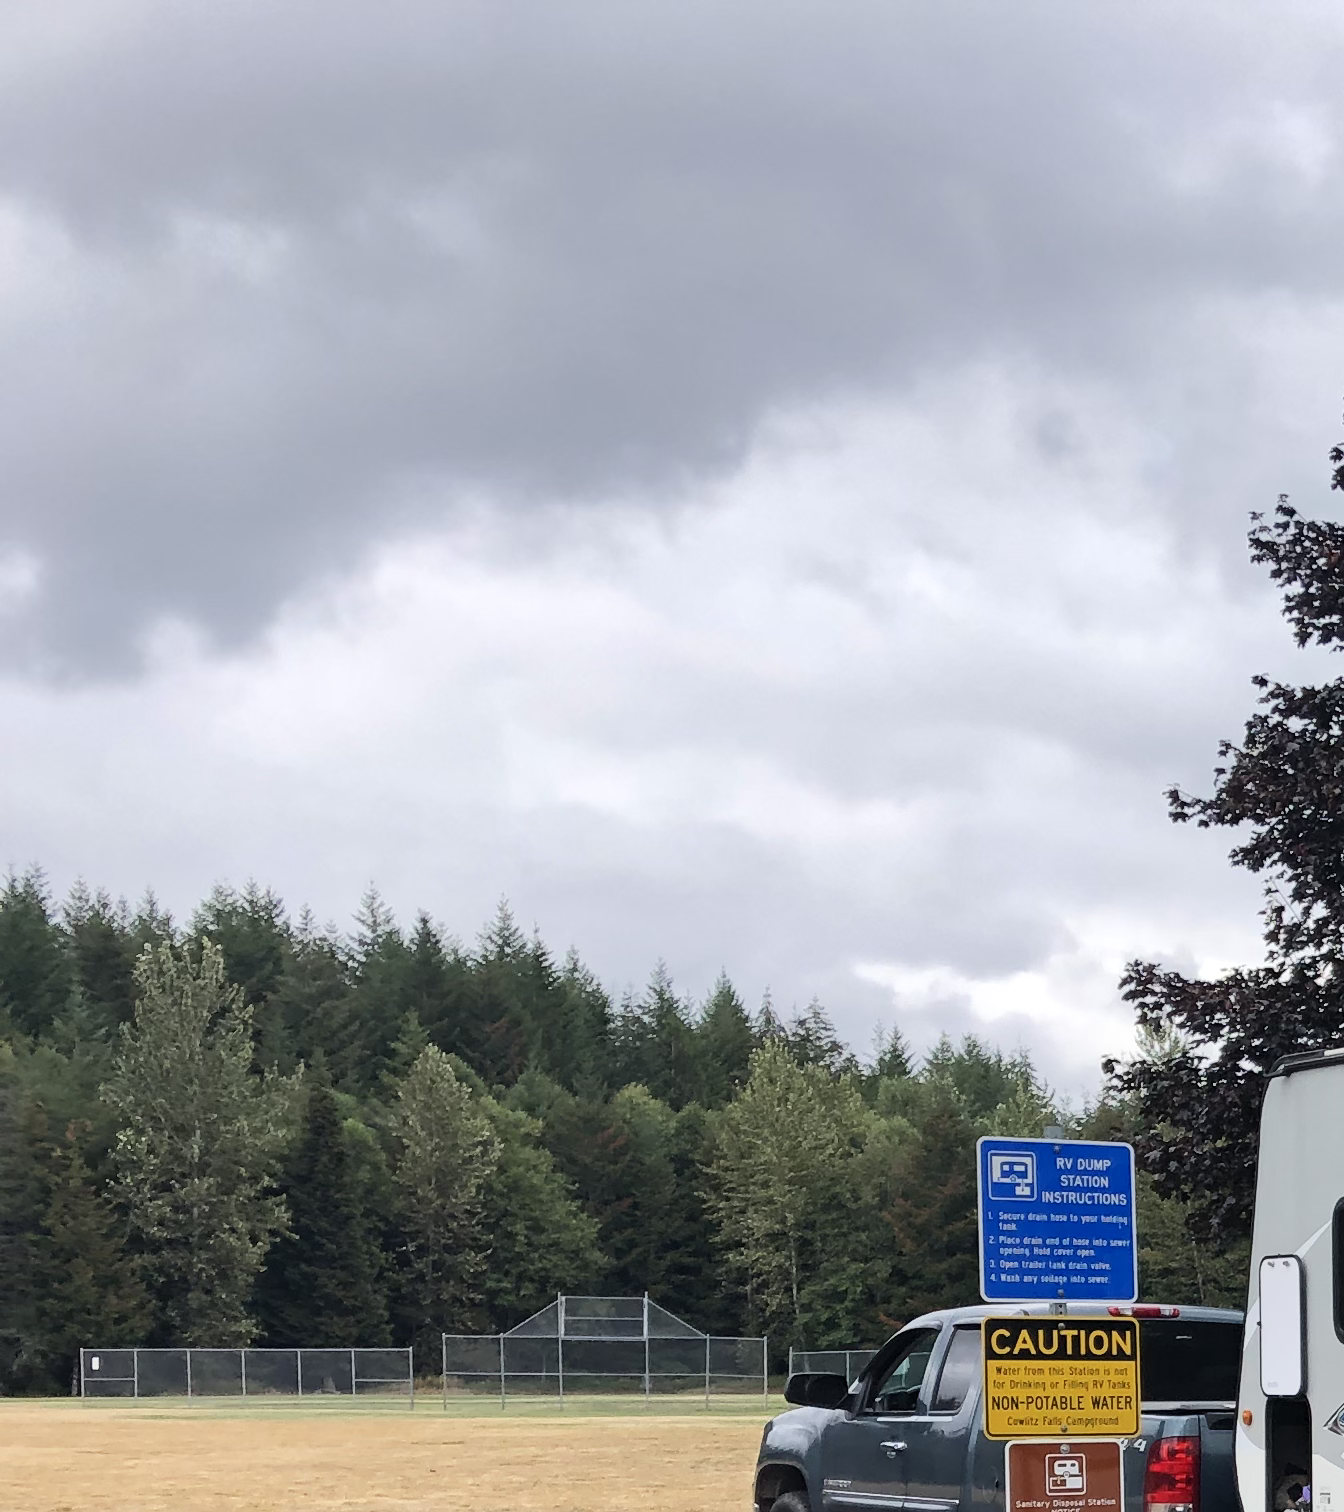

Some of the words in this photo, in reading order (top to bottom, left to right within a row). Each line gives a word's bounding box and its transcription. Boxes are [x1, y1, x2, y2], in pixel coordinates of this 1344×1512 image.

[1056, 1158, 1073, 1170] RV
[1077, 1159, 1111, 1172] DUMP
[1060, 1176, 1109, 1188] STATION
[1042, 1191, 1127, 1206] INSTRUCTIONS
[999, 1212, 1025, 1221] Secure
[1070, 1214, 1078, 1222] to
[999, 1236, 1020, 1245] Place
[1053, 1248, 1074, 1256] cover
[999, 1260, 1019, 1270] Open
[1023, 1275, 1038, 1284] any
[990, 1328, 1132, 1356] CAUTION
[996, 1366, 1020, 1376] Water
[1024, 1366, 1045, 1376] from
[1048, 1366, 1065, 1376] this
[1069, 1366, 1100, 1376] Station
[1104, 1366, 1110, 1376] is
[1114, 1367, 1128, 1376] not
[993, 1380, 1006, 1390] for
[1010, 1380, 1046, 1392] Drinking
[1050, 1382, 1060, 1390] or
[1063, 1380, 1089, 1392] Filling
[1092, 1380, 1104, 1390] RV
[1107, 1380, 1131, 1390] Tanks
[991, 1395, 1085, 1411] NON-POTABLE
[1091, 1395, 1133, 1410] WATER
[1007, 1416, 1039, 1426] Cowlitz
[1042, 1416, 1062, 1426] Falls
[1065, 1416, 1119, 1428] Campground
[1015, 1500, 1050, 1509] Sanitary
[1053, 1499, 1086, 1508] Disposal
[1087, 1498, 1116, 1506] Station
